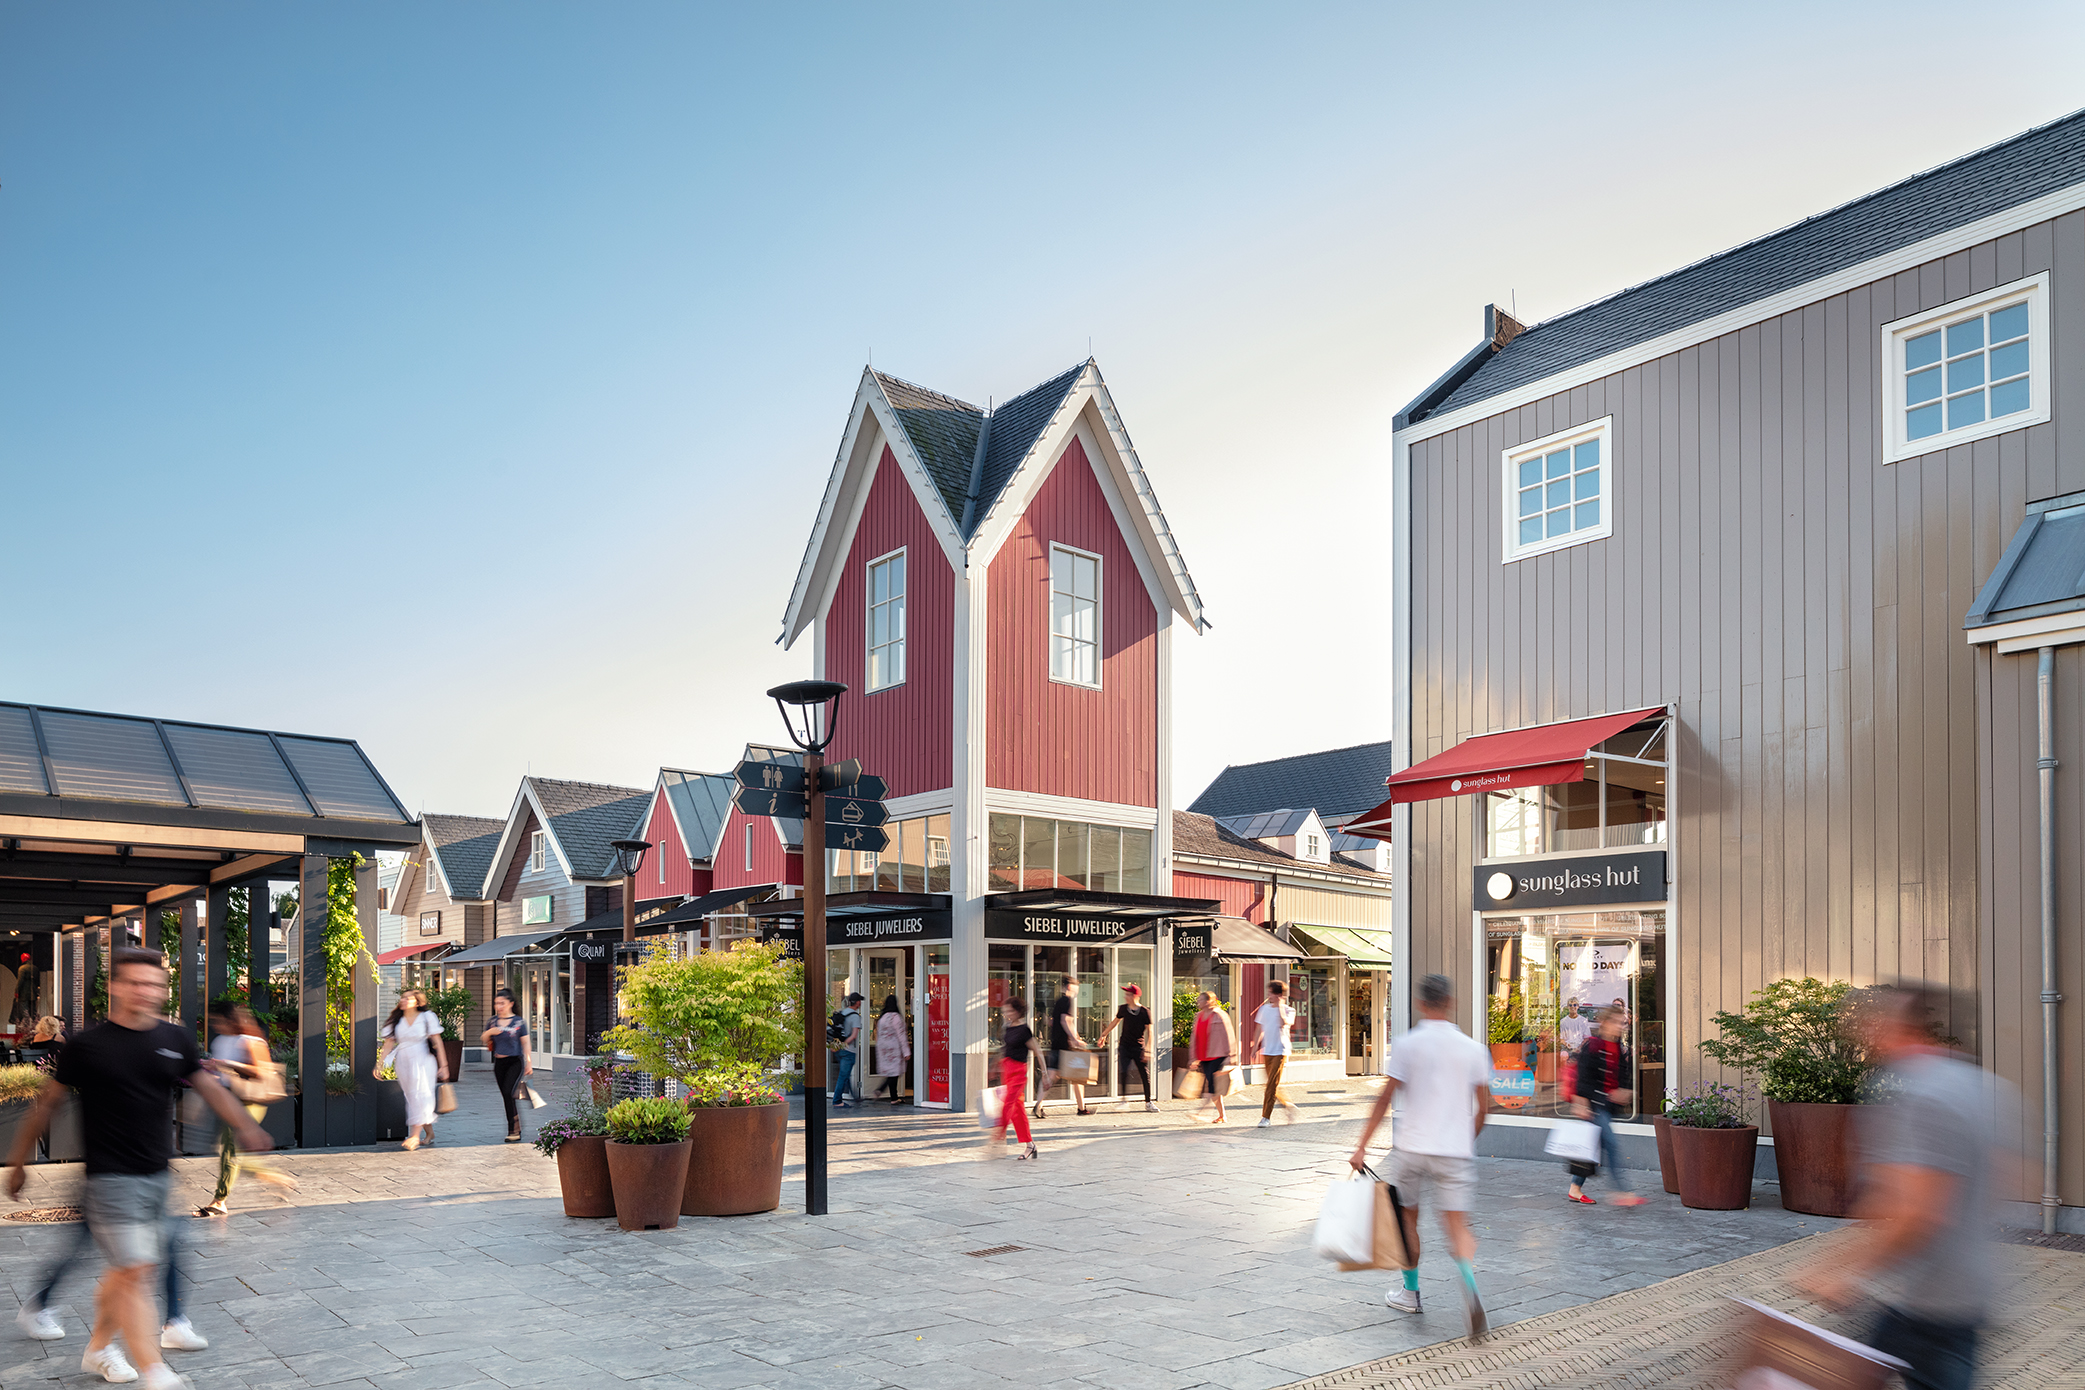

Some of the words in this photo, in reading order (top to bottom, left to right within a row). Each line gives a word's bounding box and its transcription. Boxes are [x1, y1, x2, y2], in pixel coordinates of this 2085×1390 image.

[1463, 777, 1496, 788] sunglass
[1497, 774, 1511, 783] hut
[1519, 869, 1602, 896] sunglass
[1606, 865, 1641, 887] hut
[846, 921, 873, 937] SIEBEL
[874, 917, 923, 939] JUWELIERS
[1024, 916, 1063, 934] SIEBEL
[1066, 918, 1126, 937] JUWELIERS
[1178, 936, 1206, 949] SIEBEL
[1600, 961, 1625, 970] DAYS
[1491, 1077, 1531, 1090] SALE
